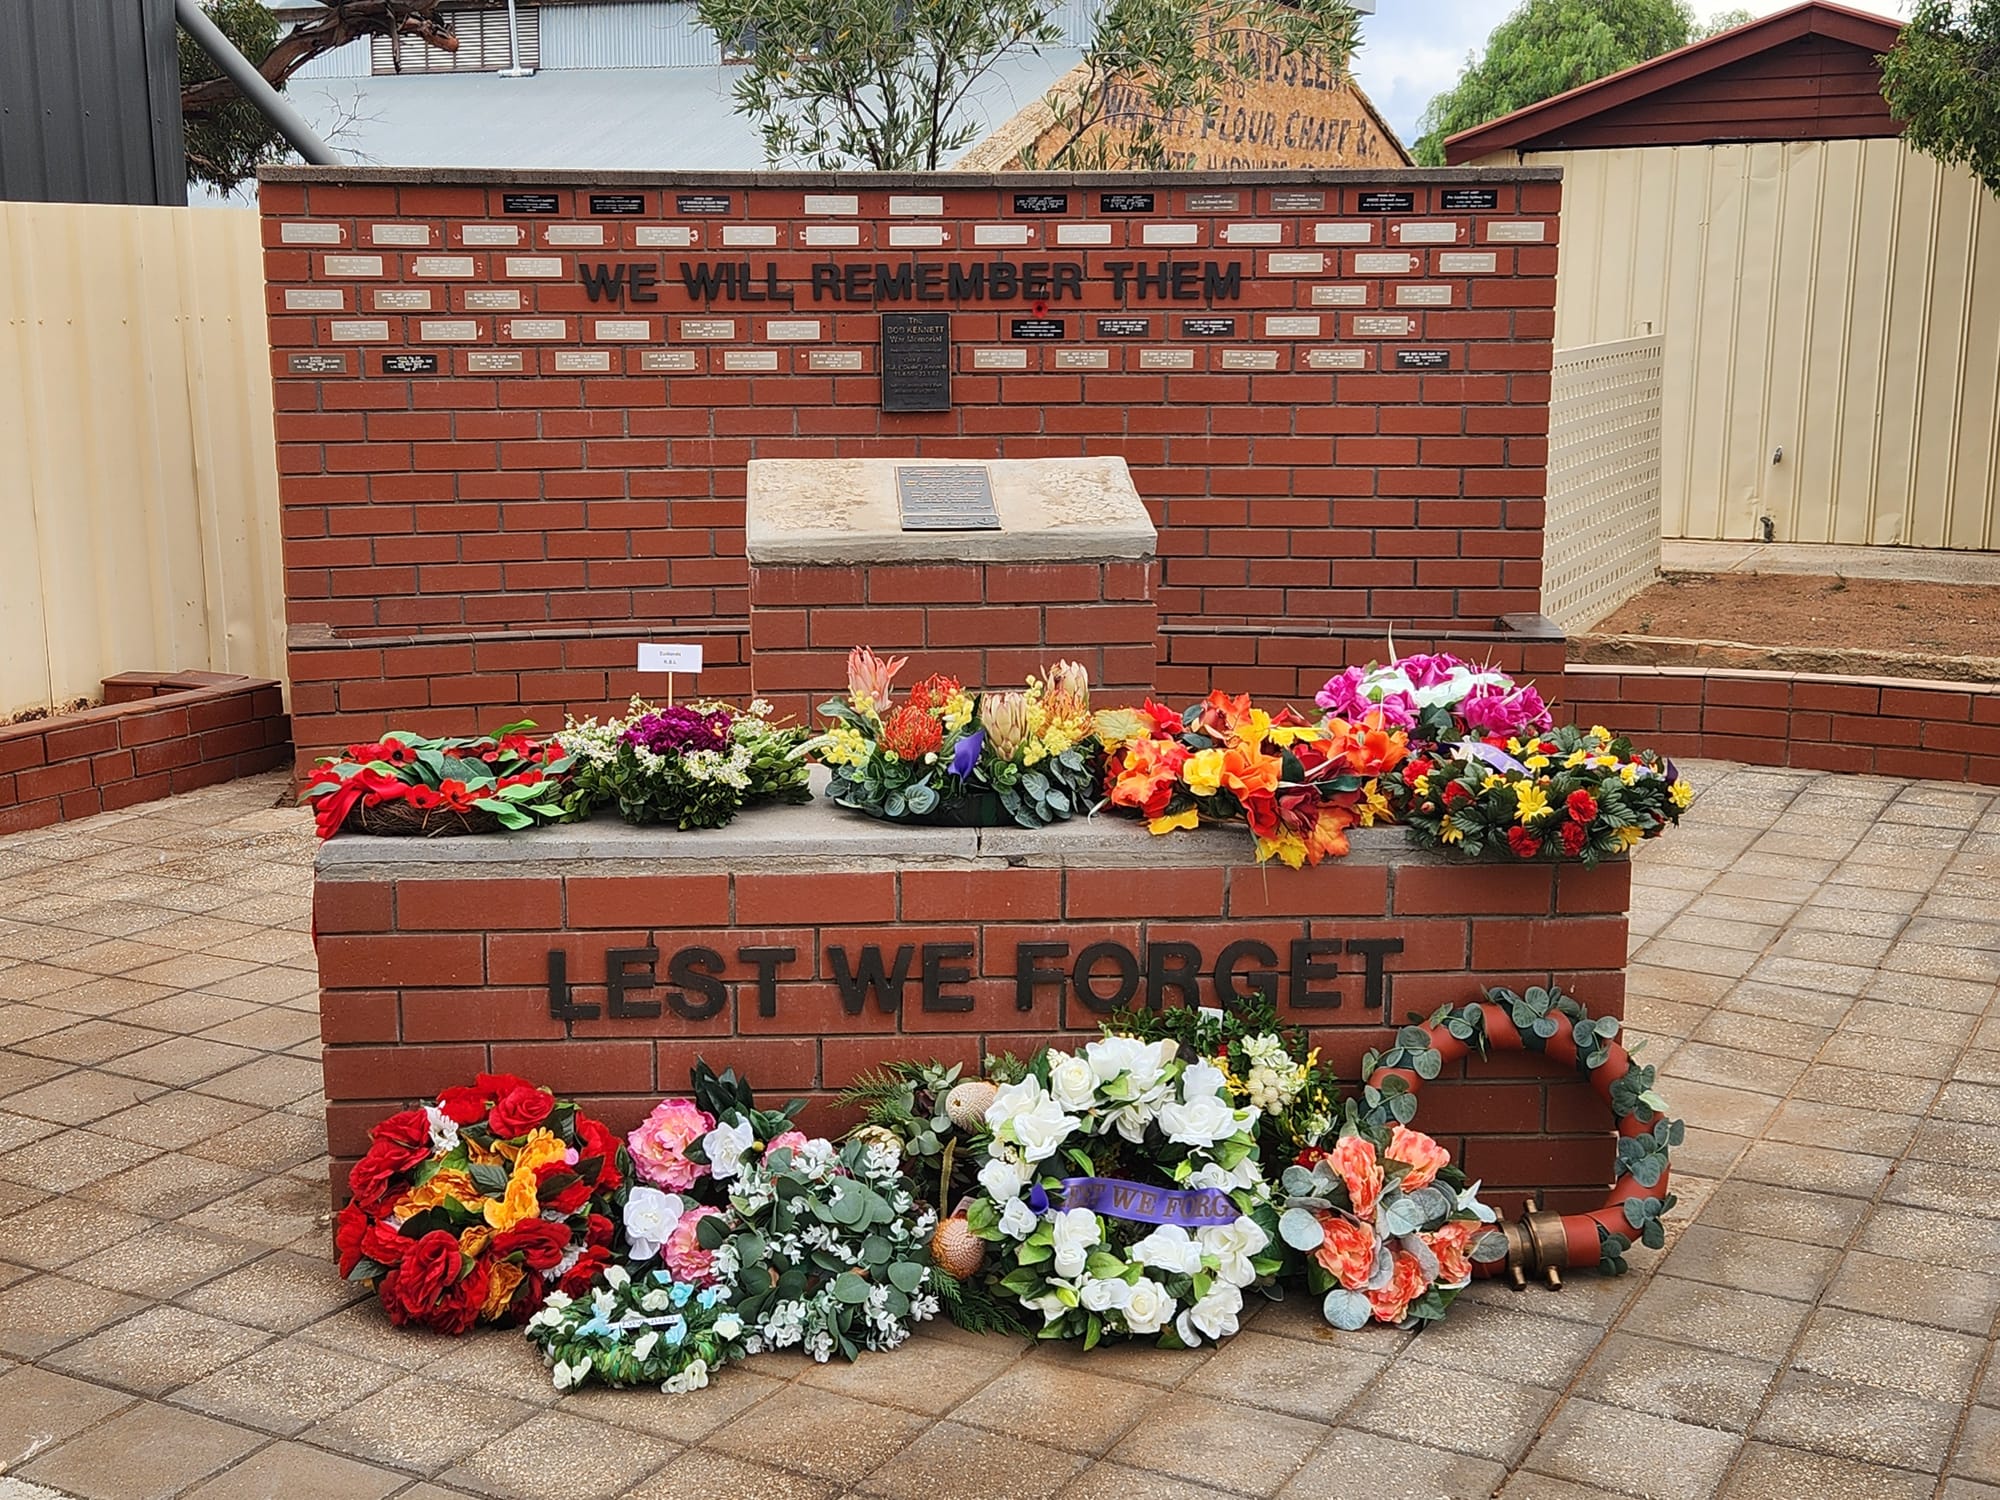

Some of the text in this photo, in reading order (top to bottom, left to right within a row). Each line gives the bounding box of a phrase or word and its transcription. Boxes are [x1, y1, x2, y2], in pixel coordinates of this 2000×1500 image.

[1284, 109, 1351, 152] CHAFF
[579, 263, 658, 302] WE
[680, 262, 794, 301] WILL
[811, 261, 1083, 301] REMEMBER
[1104, 261, 1241, 300] THEM
[906, 325, 945, 334] KENNETT
[547, 939, 1404, 1021] LEST WE FORGET
[1112, 1185, 1158, 1216] WE
[1163, 1194, 1243, 1218] FORG
